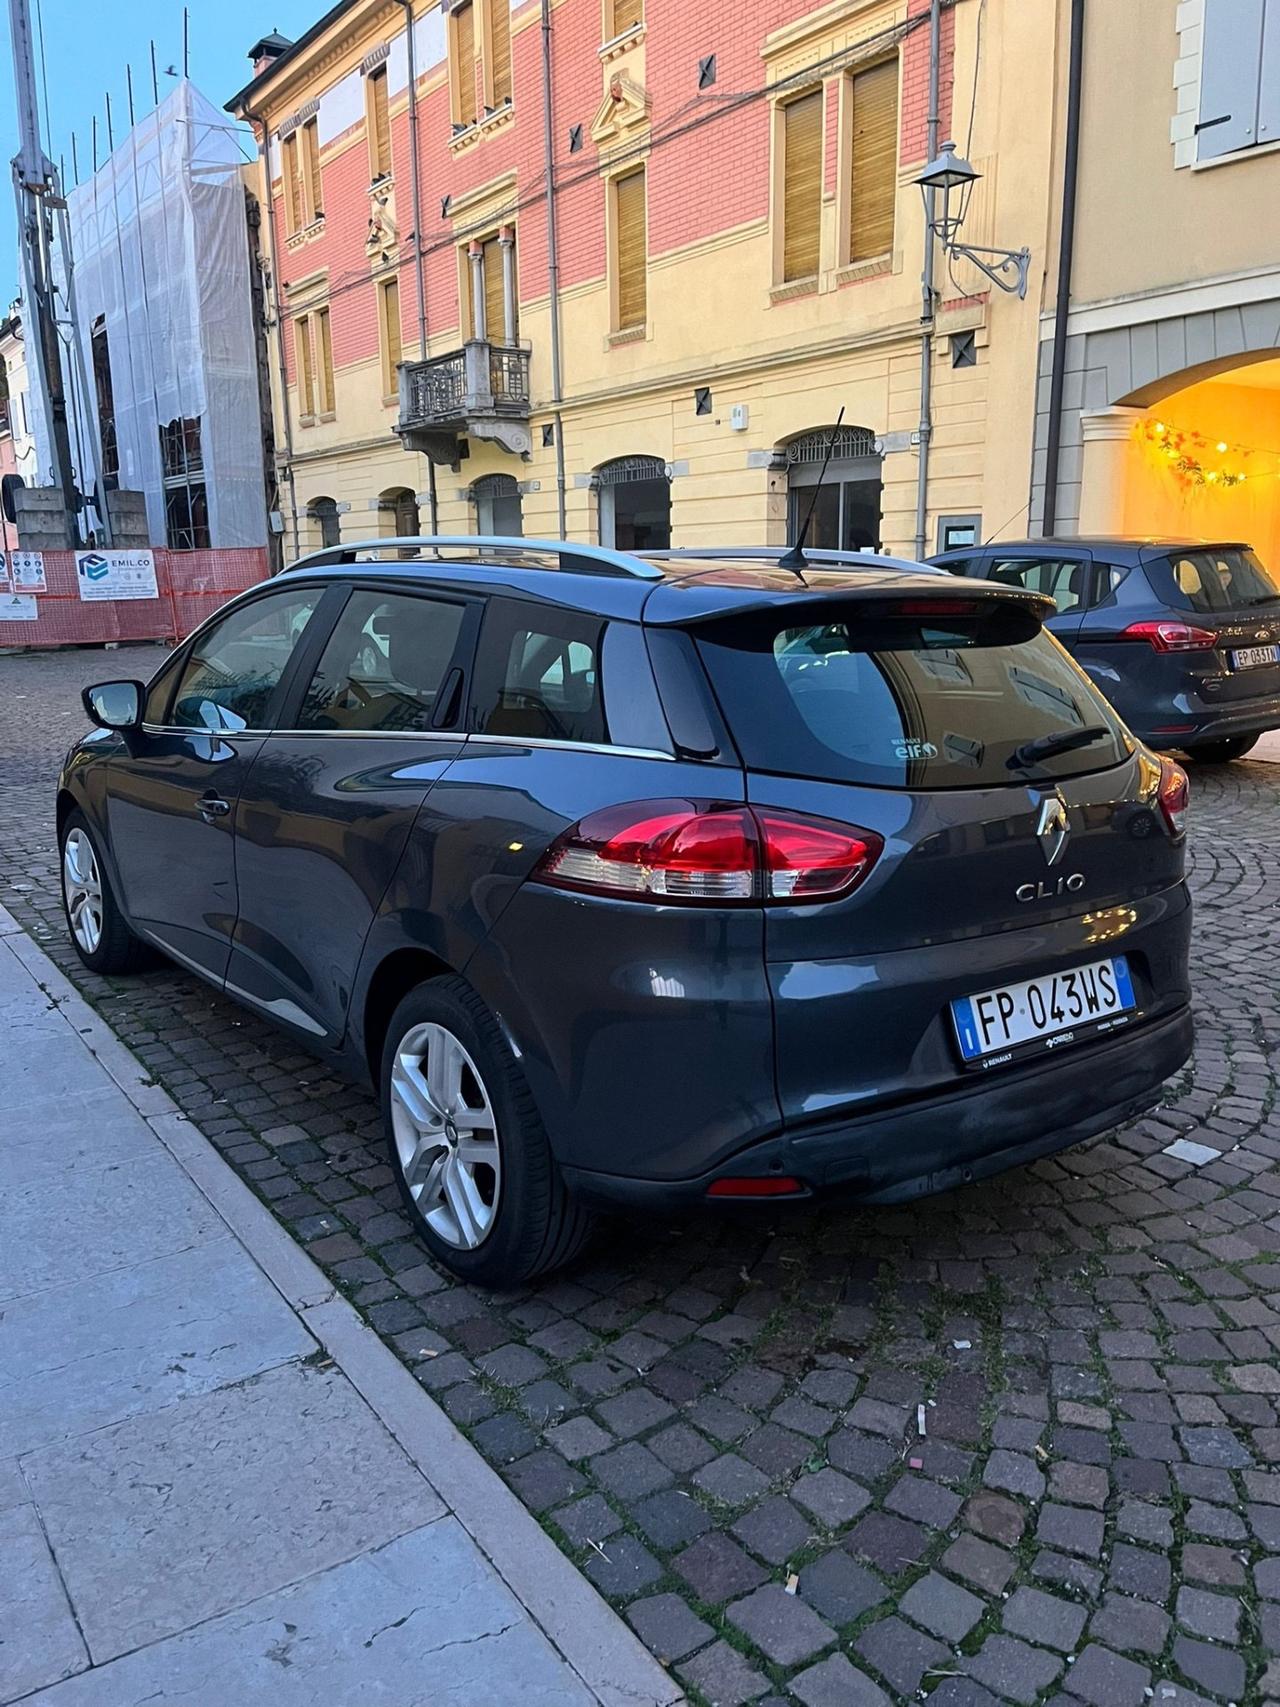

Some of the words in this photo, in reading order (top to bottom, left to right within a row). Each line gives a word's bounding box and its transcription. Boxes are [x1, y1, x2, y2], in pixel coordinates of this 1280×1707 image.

[111, 559, 150, 567] EMIL.CO
[1015, 872, 1086, 902] CLIO
[988, 1053, 1012, 1067] RENAULT
